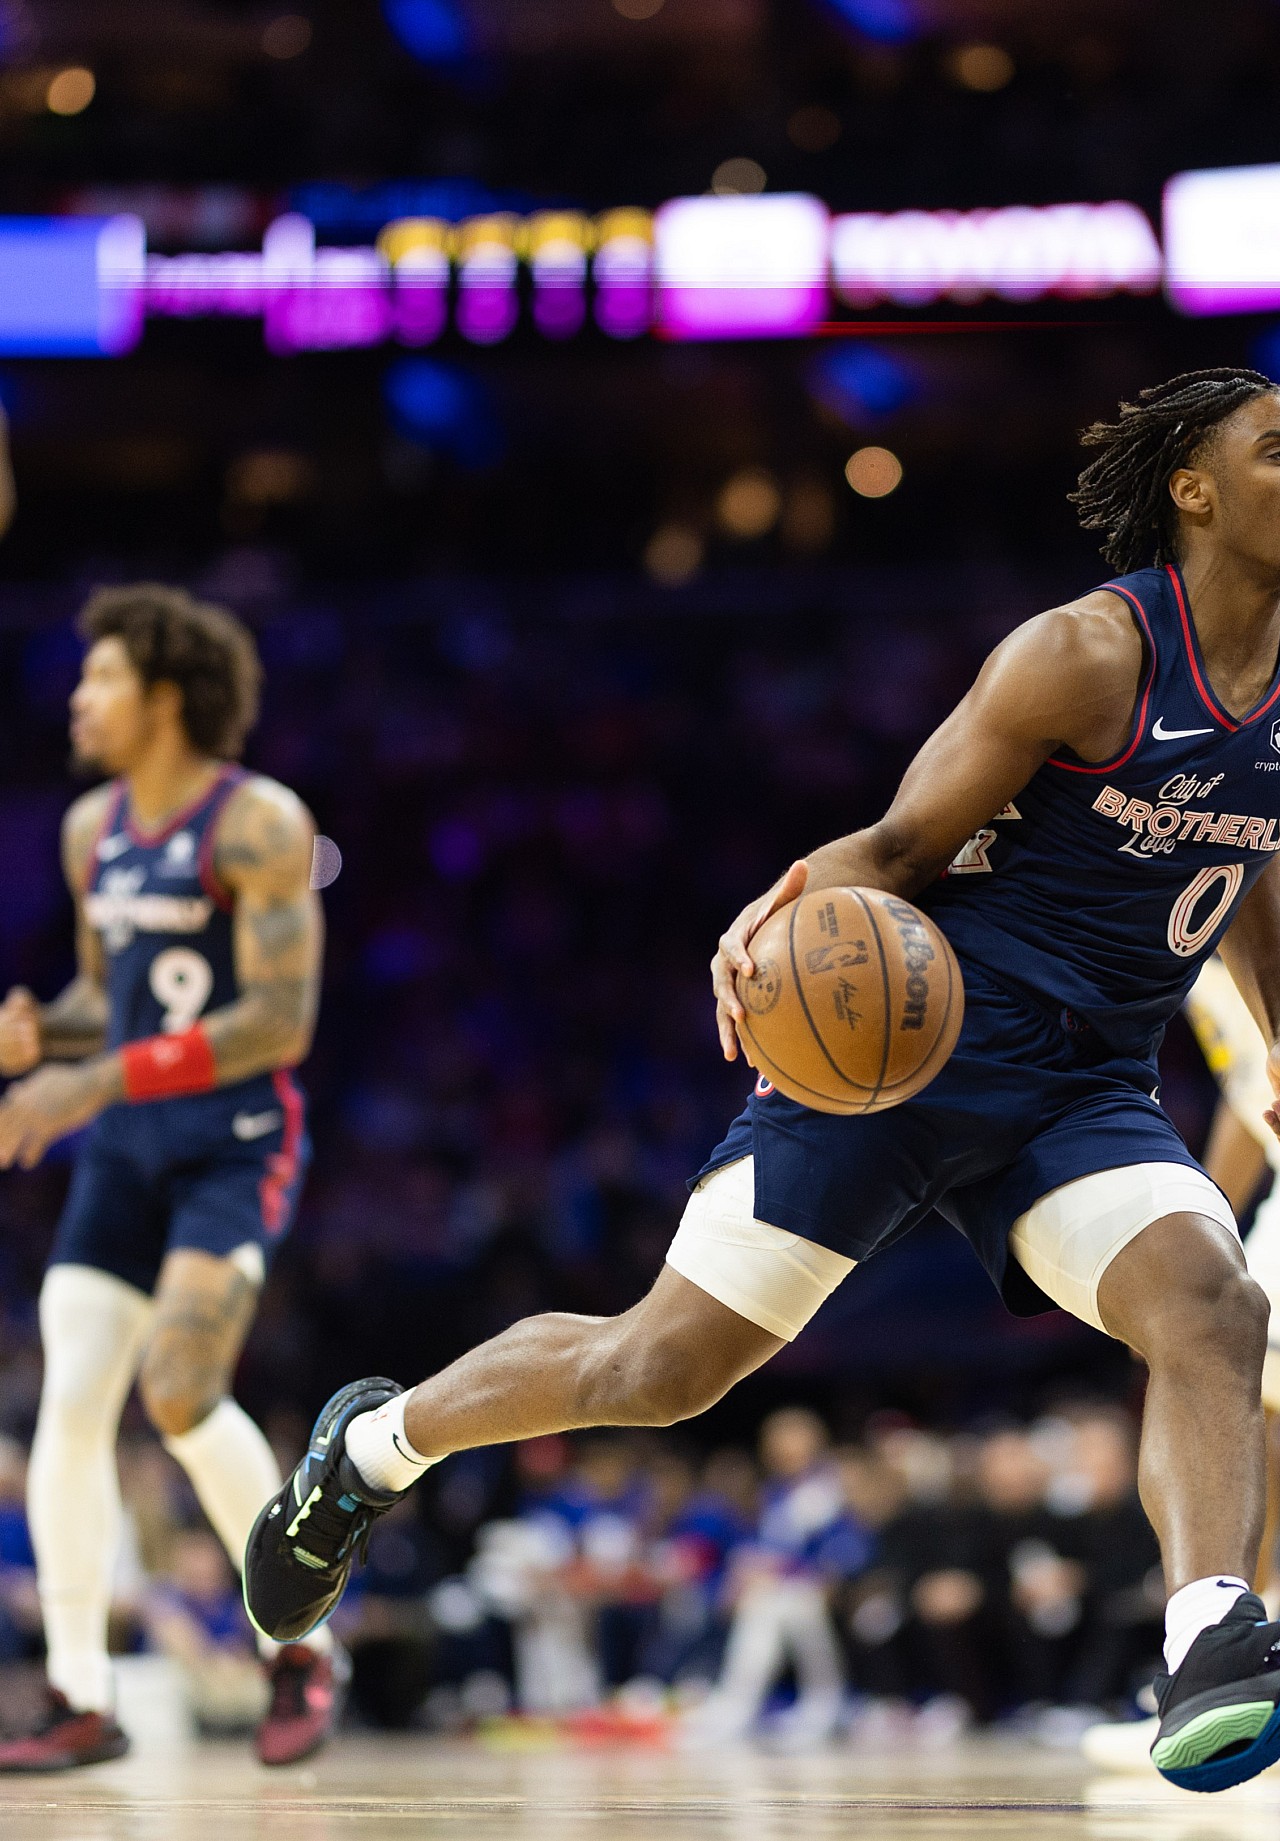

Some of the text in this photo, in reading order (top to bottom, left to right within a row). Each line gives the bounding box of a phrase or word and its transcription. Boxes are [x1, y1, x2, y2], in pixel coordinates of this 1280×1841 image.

[1156, 772, 1225, 808] City of
[1167, 864, 1244, 958] 0
[150, 946, 213, 1035] 9
[882, 897, 935, 1032] Wilson
